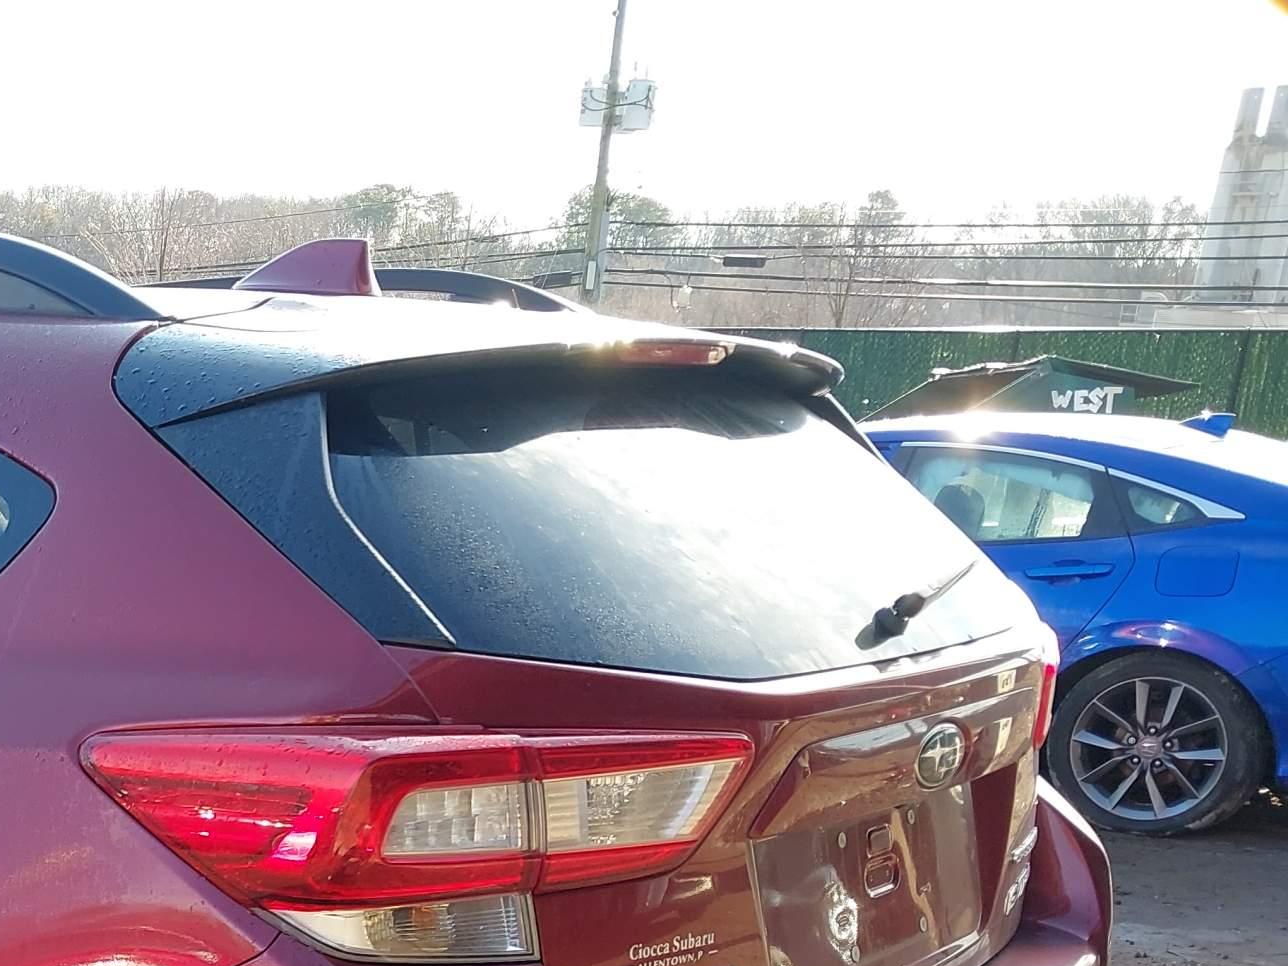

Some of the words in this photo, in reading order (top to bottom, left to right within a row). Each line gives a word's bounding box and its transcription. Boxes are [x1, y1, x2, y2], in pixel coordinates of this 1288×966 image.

[1051, 386, 1124, 414] WEST
[628, 942, 671, 961] Ciocca
[672, 931, 716, 953] Subaru
